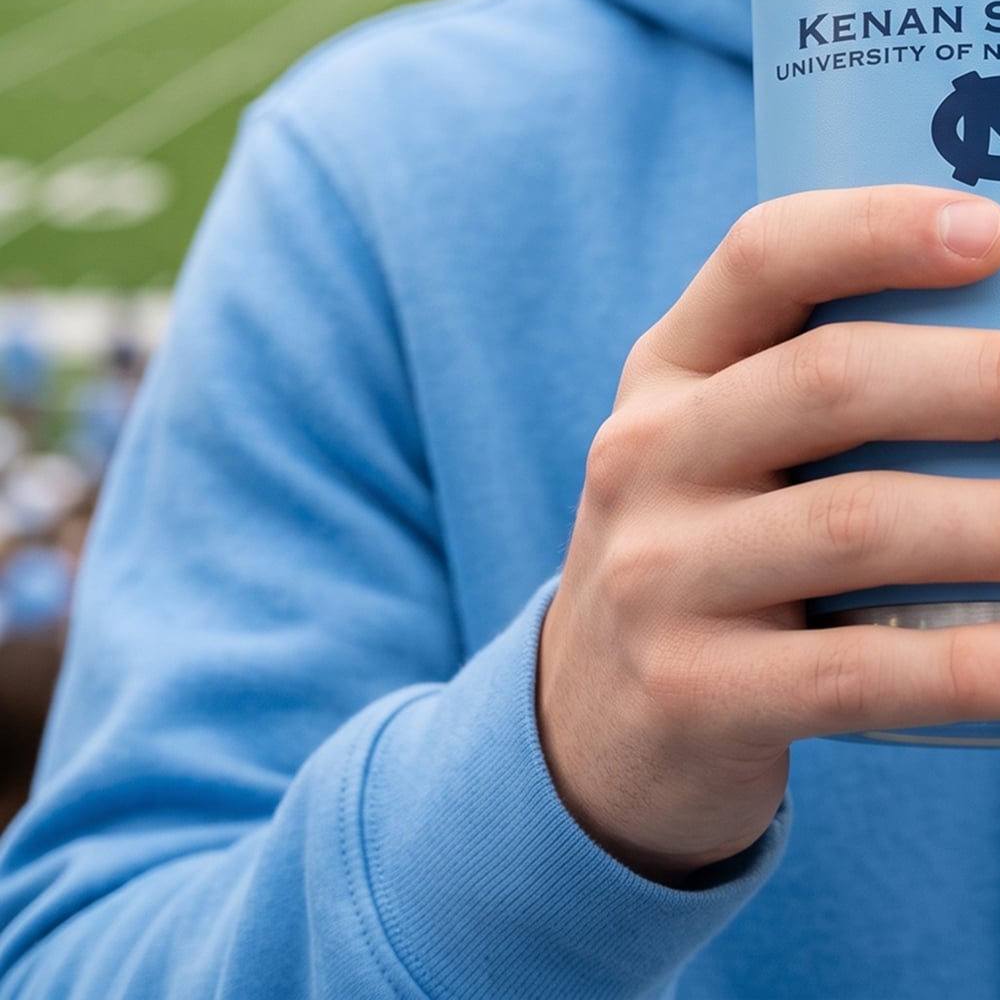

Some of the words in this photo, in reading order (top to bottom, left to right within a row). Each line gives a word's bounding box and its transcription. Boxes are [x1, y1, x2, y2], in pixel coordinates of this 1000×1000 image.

[798, 6, 964, 50] KENAN
[776, 44, 924, 81] UNIVERSITY
[935, 43, 973, 61] OF
